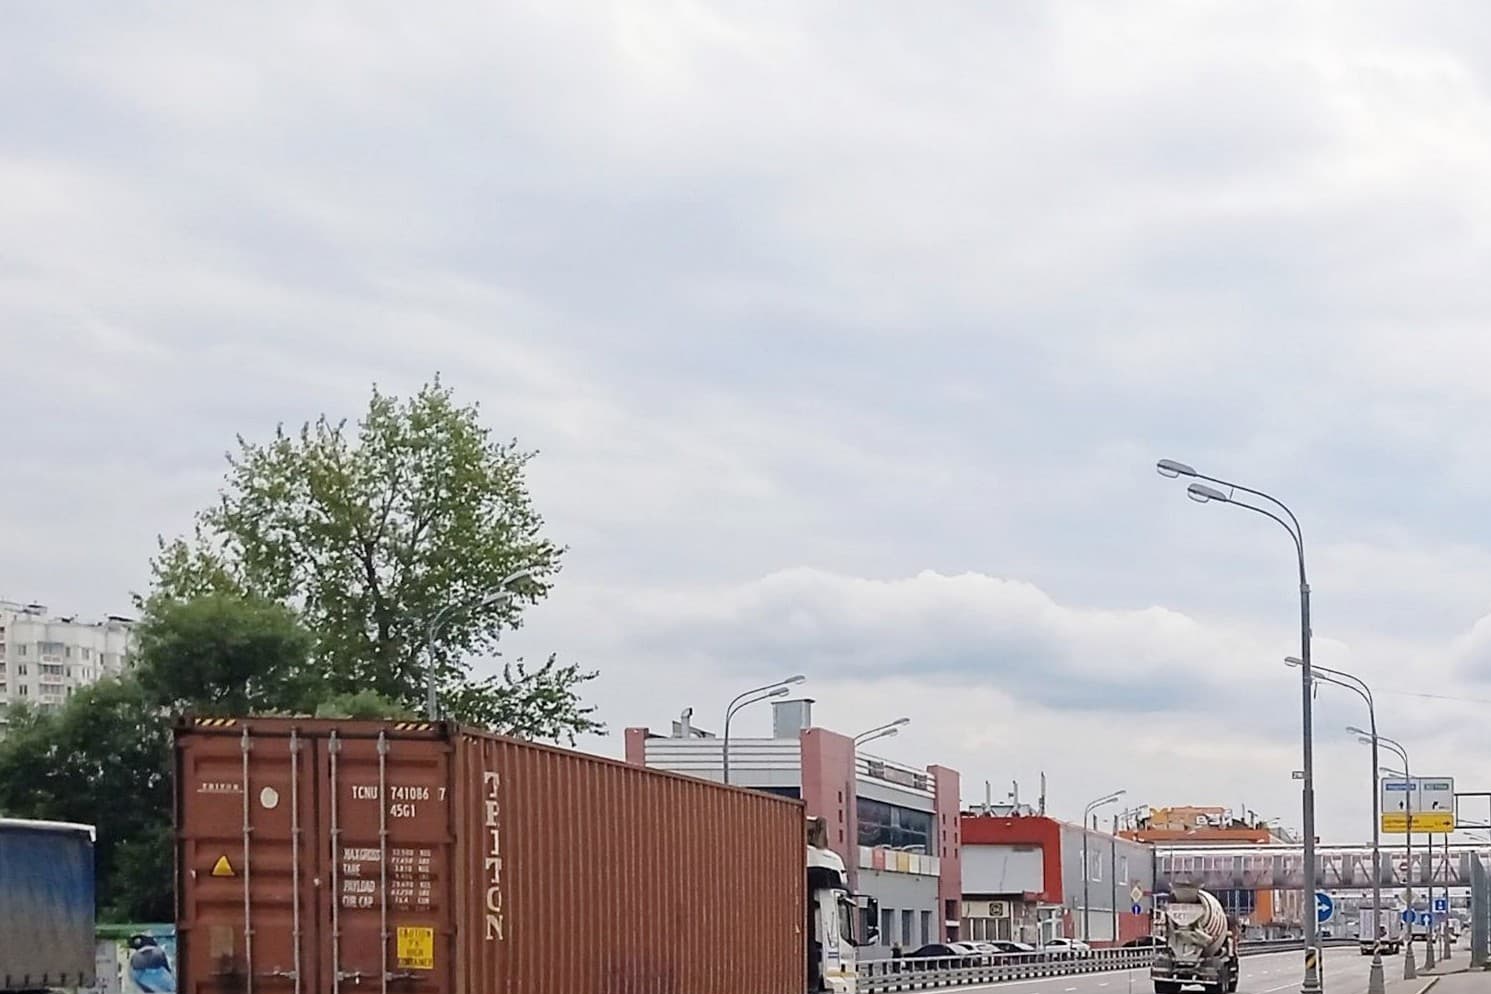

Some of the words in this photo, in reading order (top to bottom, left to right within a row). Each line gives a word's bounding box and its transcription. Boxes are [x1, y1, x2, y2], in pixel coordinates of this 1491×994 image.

[352, 785, 378, 799] TCNU
[439, 787, 446, 801] 7
[390, 804, 416, 817] 45G1
[484, 771, 504, 941] TRITON
